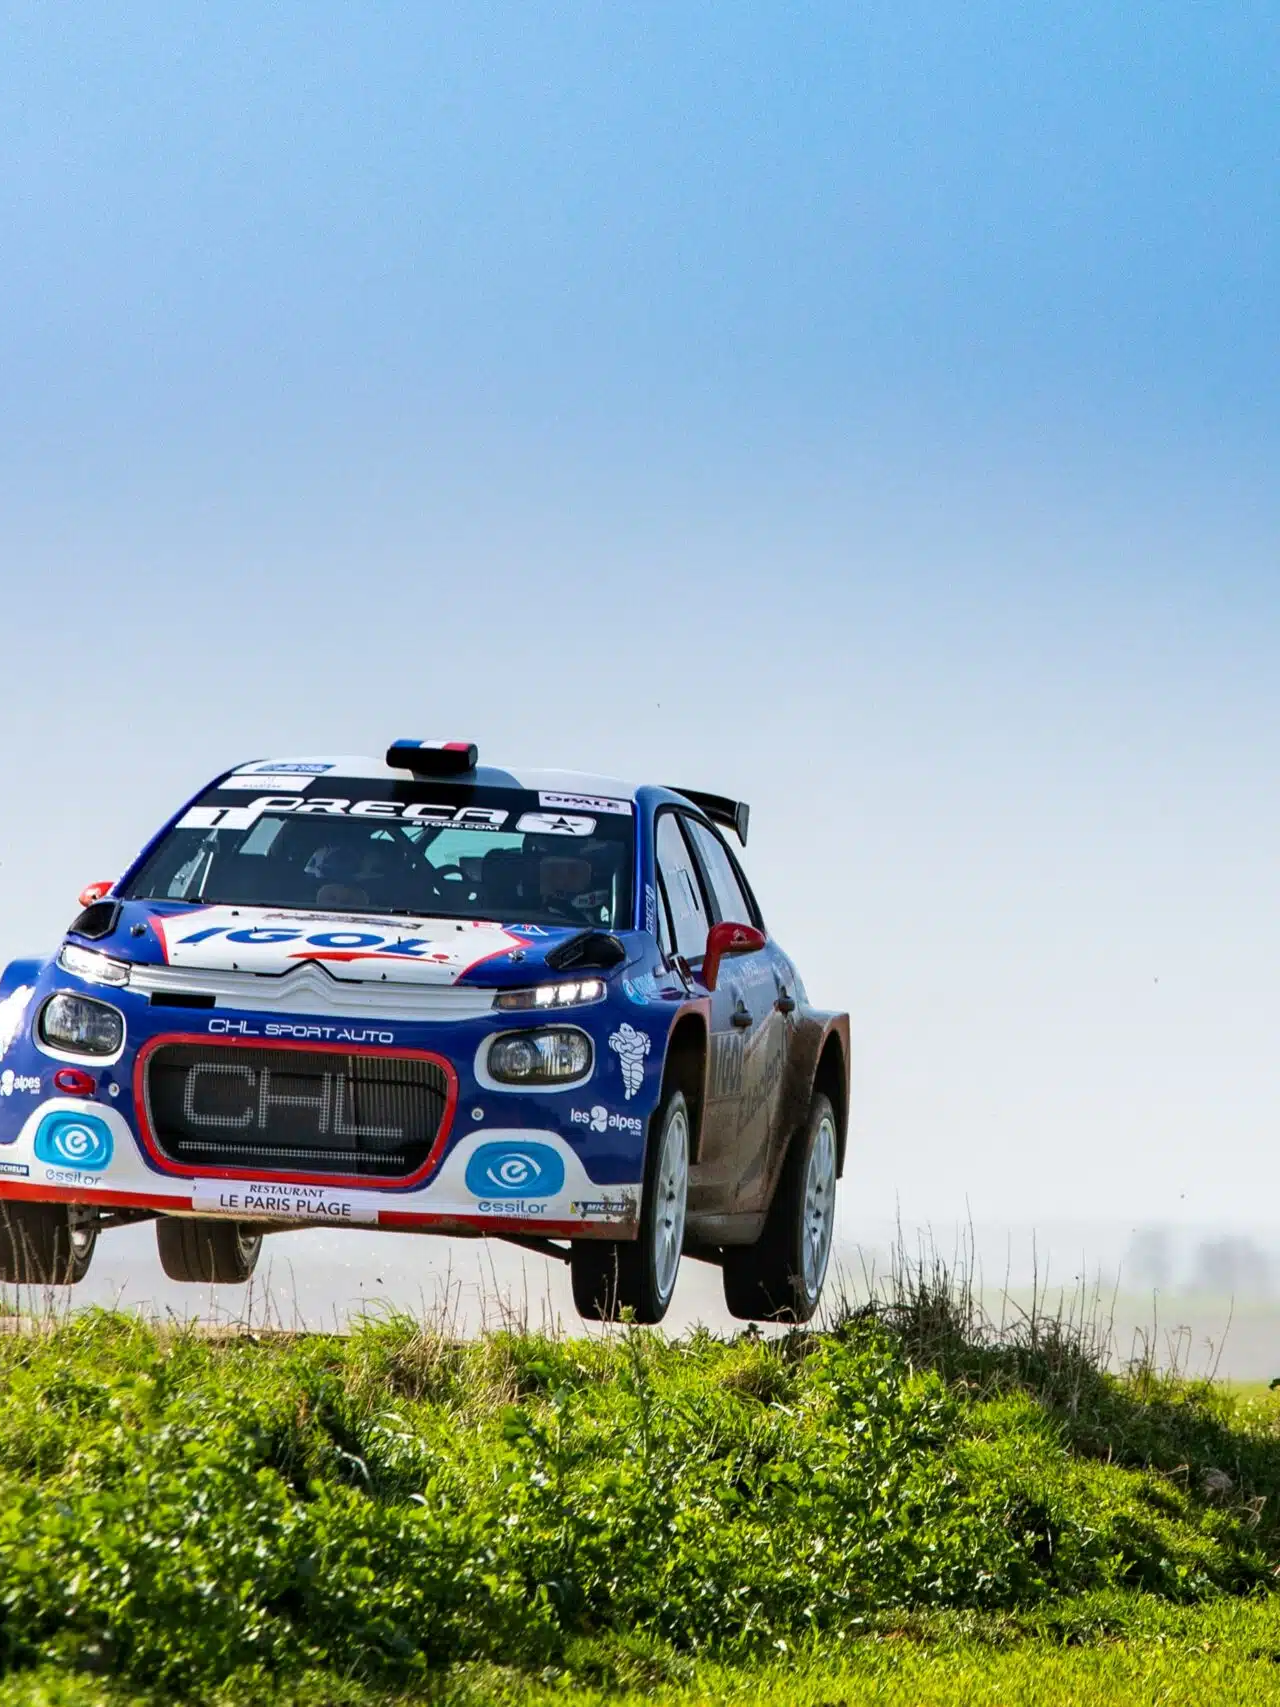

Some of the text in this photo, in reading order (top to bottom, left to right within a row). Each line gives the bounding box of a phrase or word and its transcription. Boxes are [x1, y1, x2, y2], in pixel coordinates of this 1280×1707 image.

[209, 808, 231, 827] 1
[247, 796, 510, 826] ORECA
[412, 820, 500, 832] STORE.COM
[208, 1019, 394, 1044] CHL SPORT AUTO
[184, 1062, 404, 1138] CHL
[45, 1168, 102, 1186] essilor
[249, 1184, 325, 1199] RESTAURANT
[219, 1193, 239, 1208] LE
[244, 1195, 291, 1212] PARIS
[296, 1198, 352, 1217] PLAGE
[478, 1200, 549, 1214] essilor
